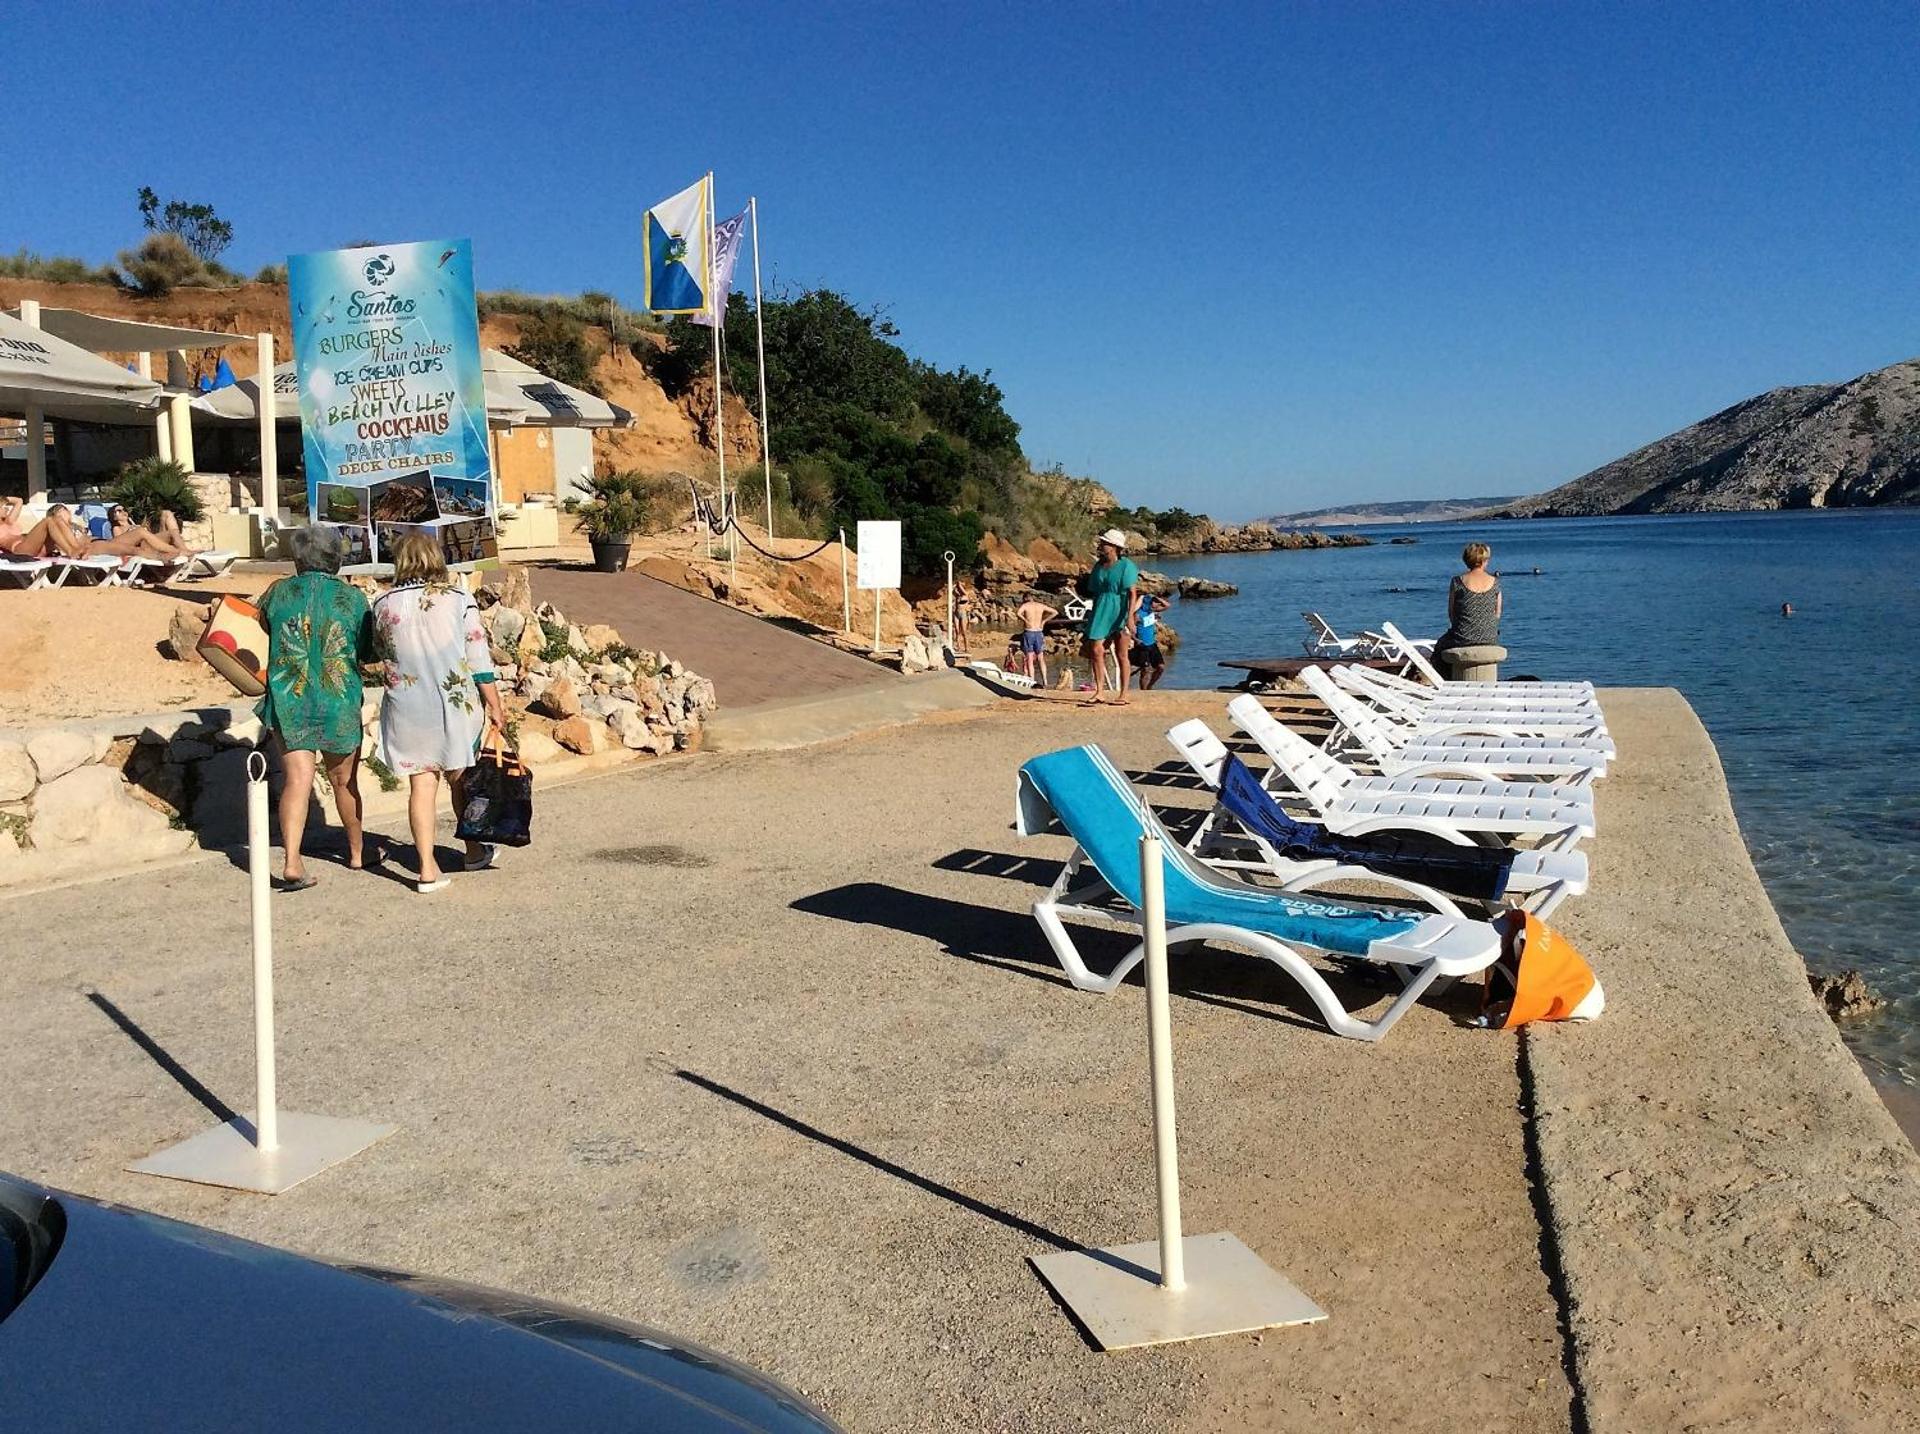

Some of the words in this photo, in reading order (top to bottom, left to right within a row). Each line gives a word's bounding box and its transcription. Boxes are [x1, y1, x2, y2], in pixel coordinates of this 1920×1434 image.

[347, 290, 417, 318] Santos
[0, 338, 50, 353] ona
[319, 326, 403, 354] BURGERS
[371, 344, 408, 362] Main
[414, 340, 452, 358] dishes
[334, 370, 354, 386] ICE
[359, 363, 405, 381] CREAM
[409, 357, 443, 375] CUPS
[351, 379, 406, 402] SWEETS
[328, 400, 383, 426] BEACH
[389, 391, 455, 416] VOLLEY
[357, 412, 450, 439] COCKTAILS
[345, 437, 413, 461] PARTY
[338, 461, 383, 476] DECK
[388, 452, 454, 470] CHAIRS
[1279, 899, 1355, 916] didas
